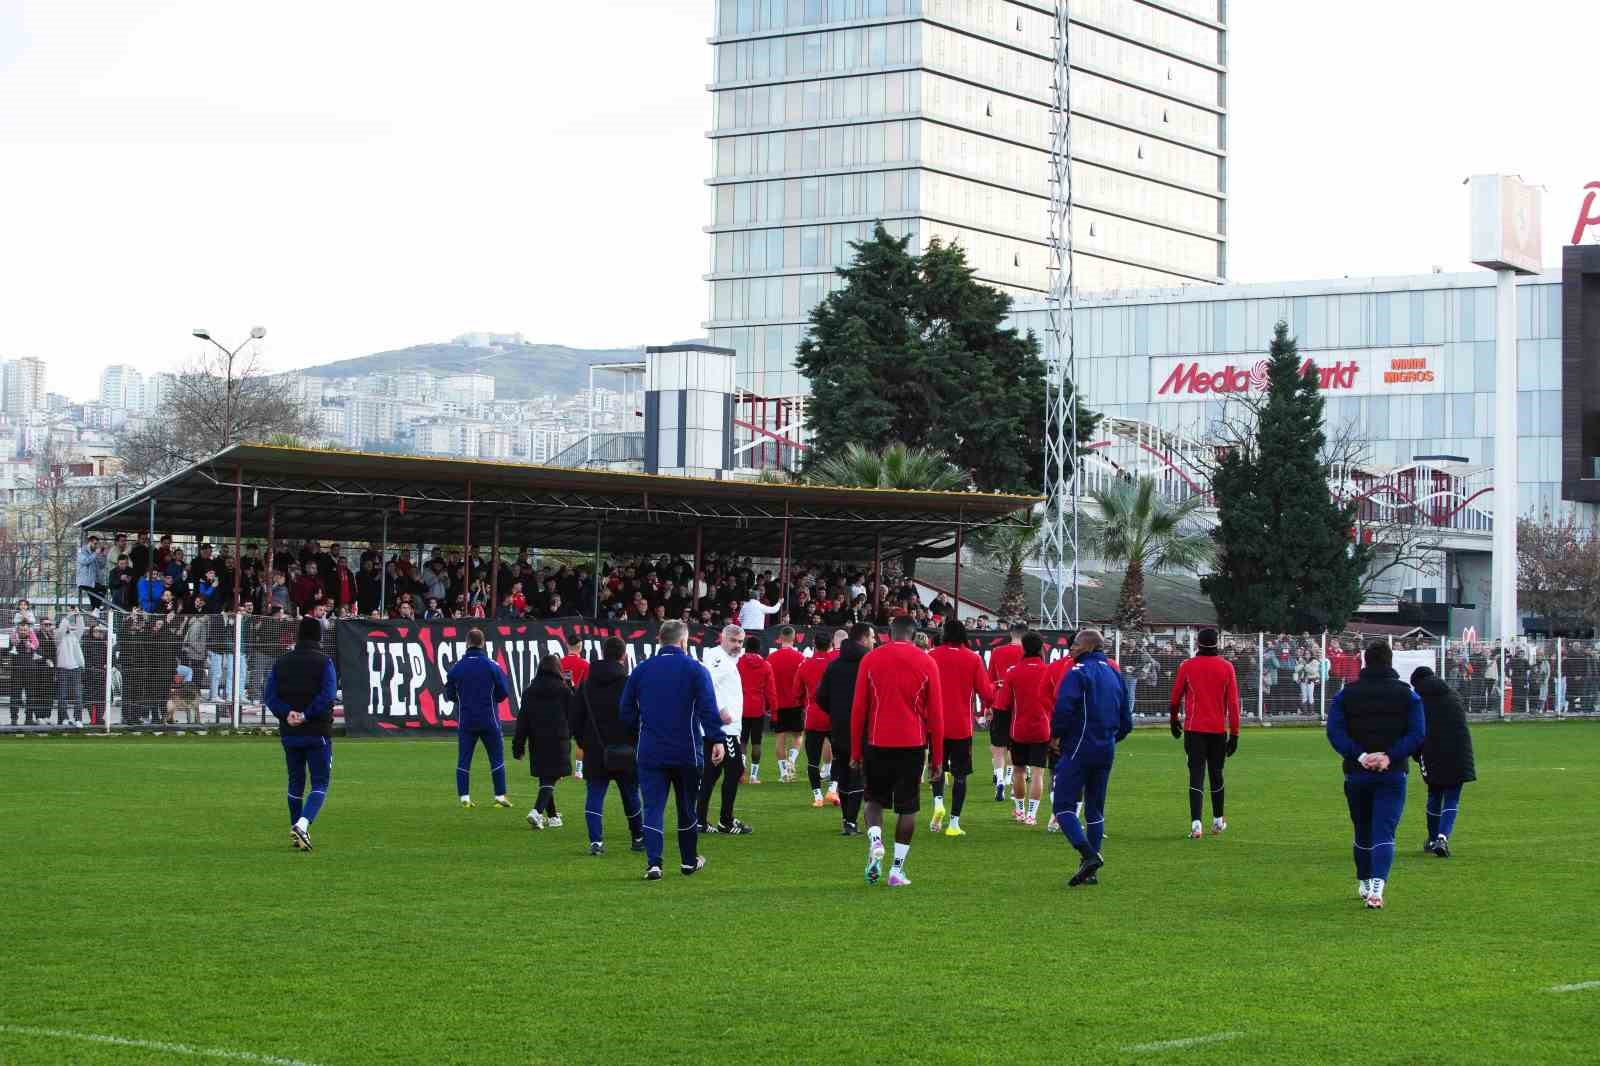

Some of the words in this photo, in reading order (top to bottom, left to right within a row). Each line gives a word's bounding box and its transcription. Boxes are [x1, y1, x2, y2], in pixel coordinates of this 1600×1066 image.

[1157, 362, 1250, 395] Media
[1383, 370, 1435, 384] MIGROS
[366, 641, 427, 716] HEP
